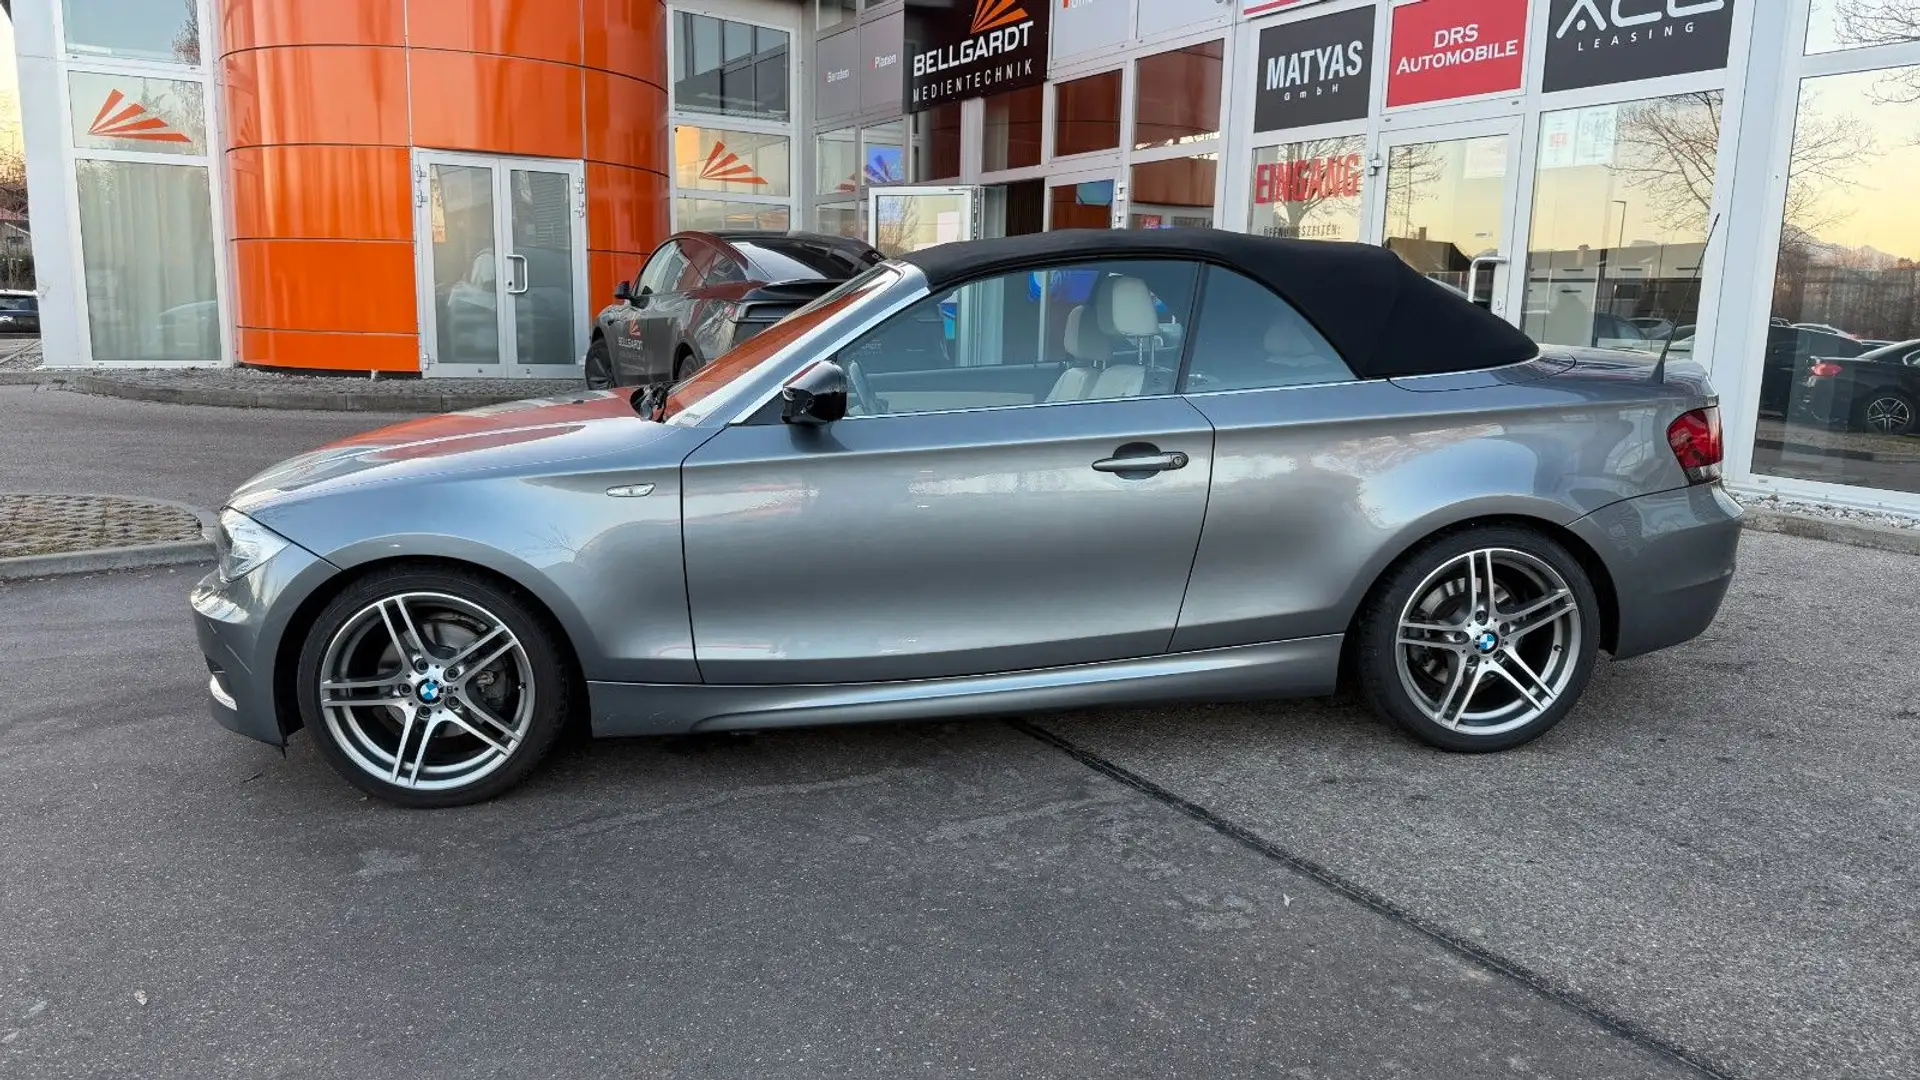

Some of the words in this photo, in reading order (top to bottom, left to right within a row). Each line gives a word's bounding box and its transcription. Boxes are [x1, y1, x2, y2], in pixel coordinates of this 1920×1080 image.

[913, 20, 1034, 77] BELLGARDT
[1433, 23, 1479, 49] DRS
[1577, 21, 1694, 51] LEASING
[874, 53, 897, 69] Planen
[1265, 40, 1364, 90] MATYAS
[1395, 39, 1518, 76] AUTOMOBILE
[913, 58, 1033, 102] MEDIENTECHNIK
[1255, 153, 1360, 204] EINGANG
